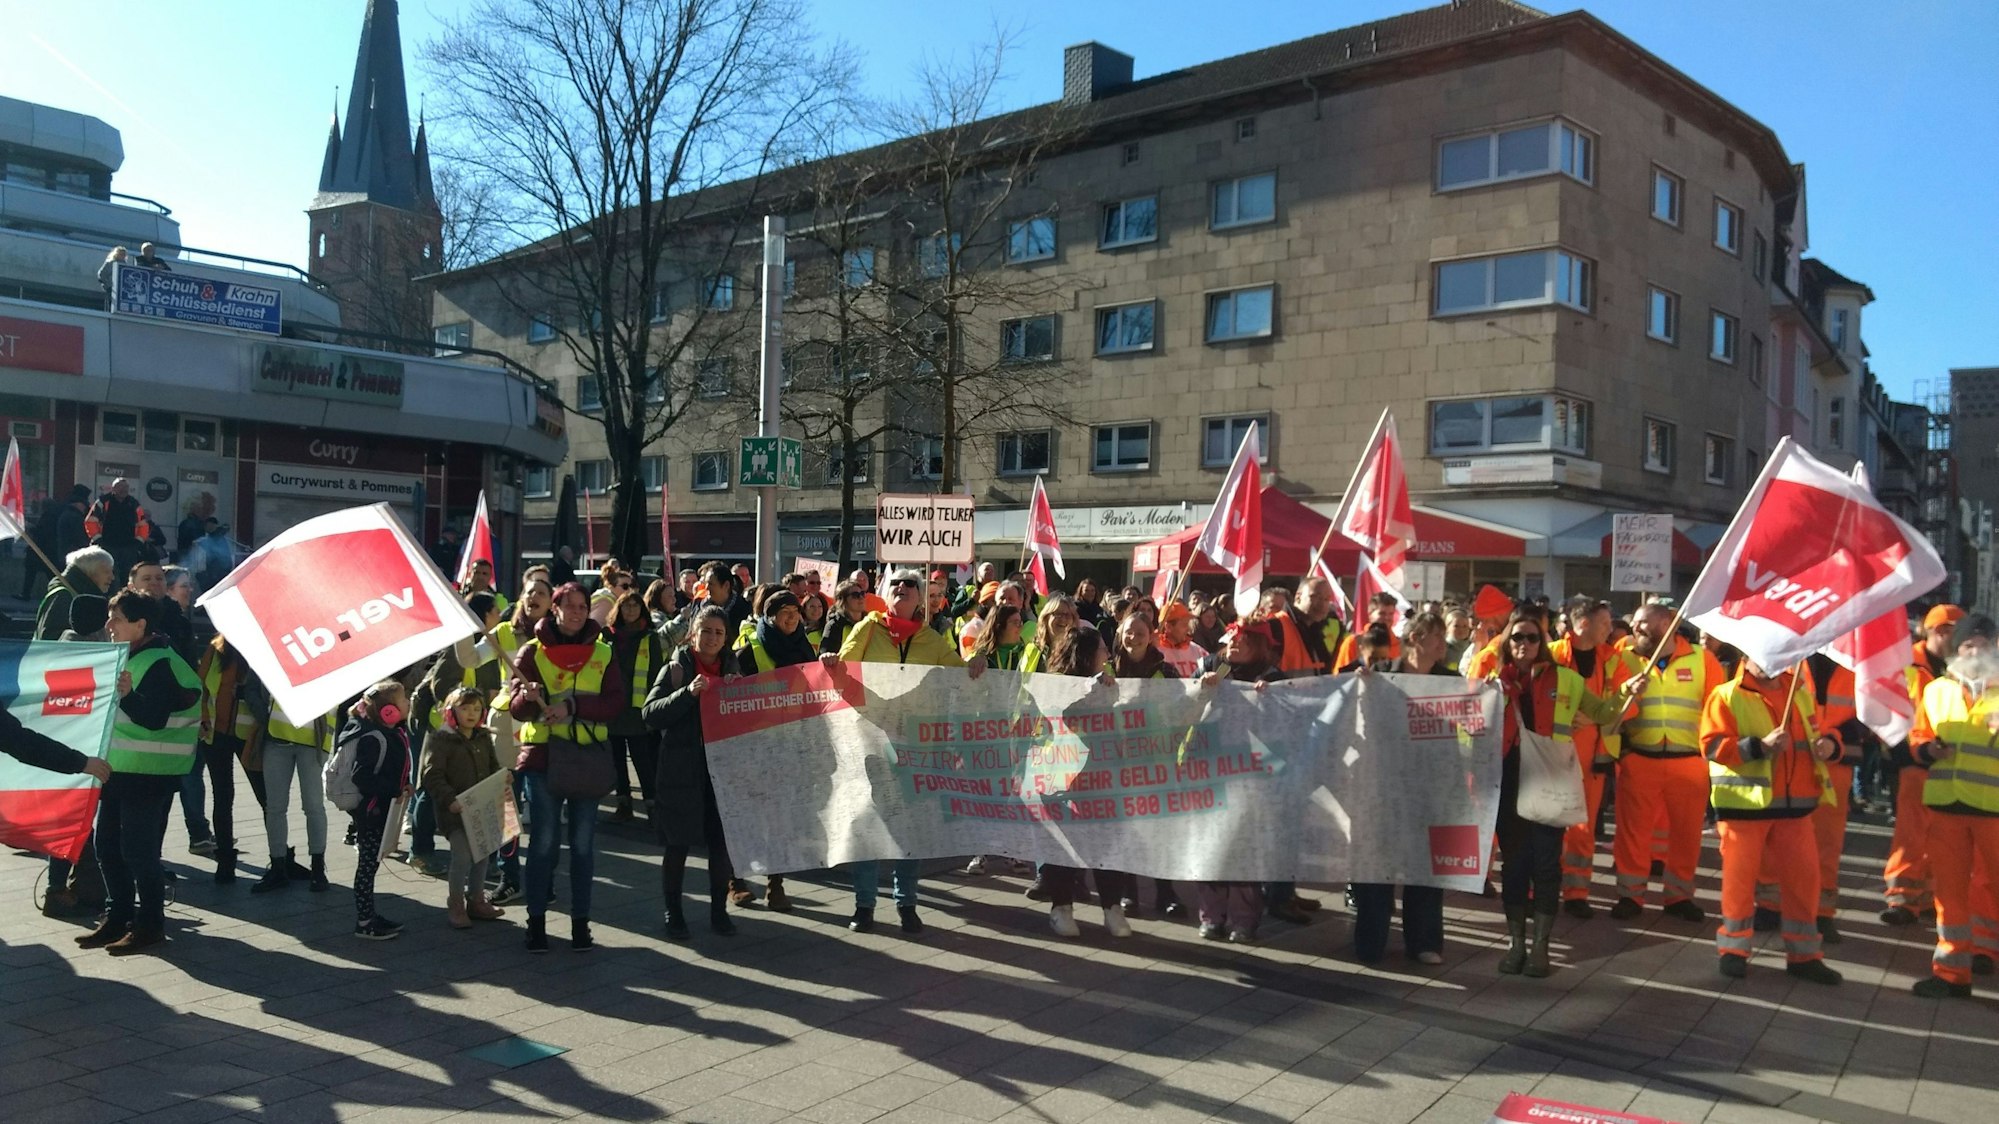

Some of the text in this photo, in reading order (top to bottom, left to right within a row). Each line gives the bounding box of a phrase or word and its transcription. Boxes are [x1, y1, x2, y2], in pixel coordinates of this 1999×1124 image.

[152, 276, 217, 301] Schuh &
[231, 286, 275, 305] Krahn
[151, 291, 266, 319] Schlüsseldienst
[175, 311, 217, 325] Gravuren
[228, 319, 264, 331] Stempel
[261, 350, 403, 396] Currywurst & Pommes
[309, 439, 360, 465] Curry
[104, 466, 125, 476] Curry
[186, 472, 206, 482] Curry
[271, 473, 413, 495] Currywurst & Pommes
[878, 506, 975, 522] ALLES WIRD TEURER
[797, 536, 831, 550] Espresso
[879, 528, 962, 547] WIR AUCH
[719, 689, 844, 715] ÖFFENTLICHER DIENST
[1407, 699, 1482, 719] ZUSAMMEN
[919, 722, 955, 743] DIE
[1122, 709, 1146, 730] IM
[1409, 719, 1444, 735] GEHT
[895, 748, 965, 770] BEZIRK
[913, 773, 993, 796] FORDERN
[1064, 770, 1113, 792] MEHR
[1120, 764, 1168, 788] GELD
[1175, 756, 1211, 783] FÜR
[1216, 752, 1274, 777] ALLE,
[950, 787, 1223, 822] MINDESTENS ABER 500 EURO.
